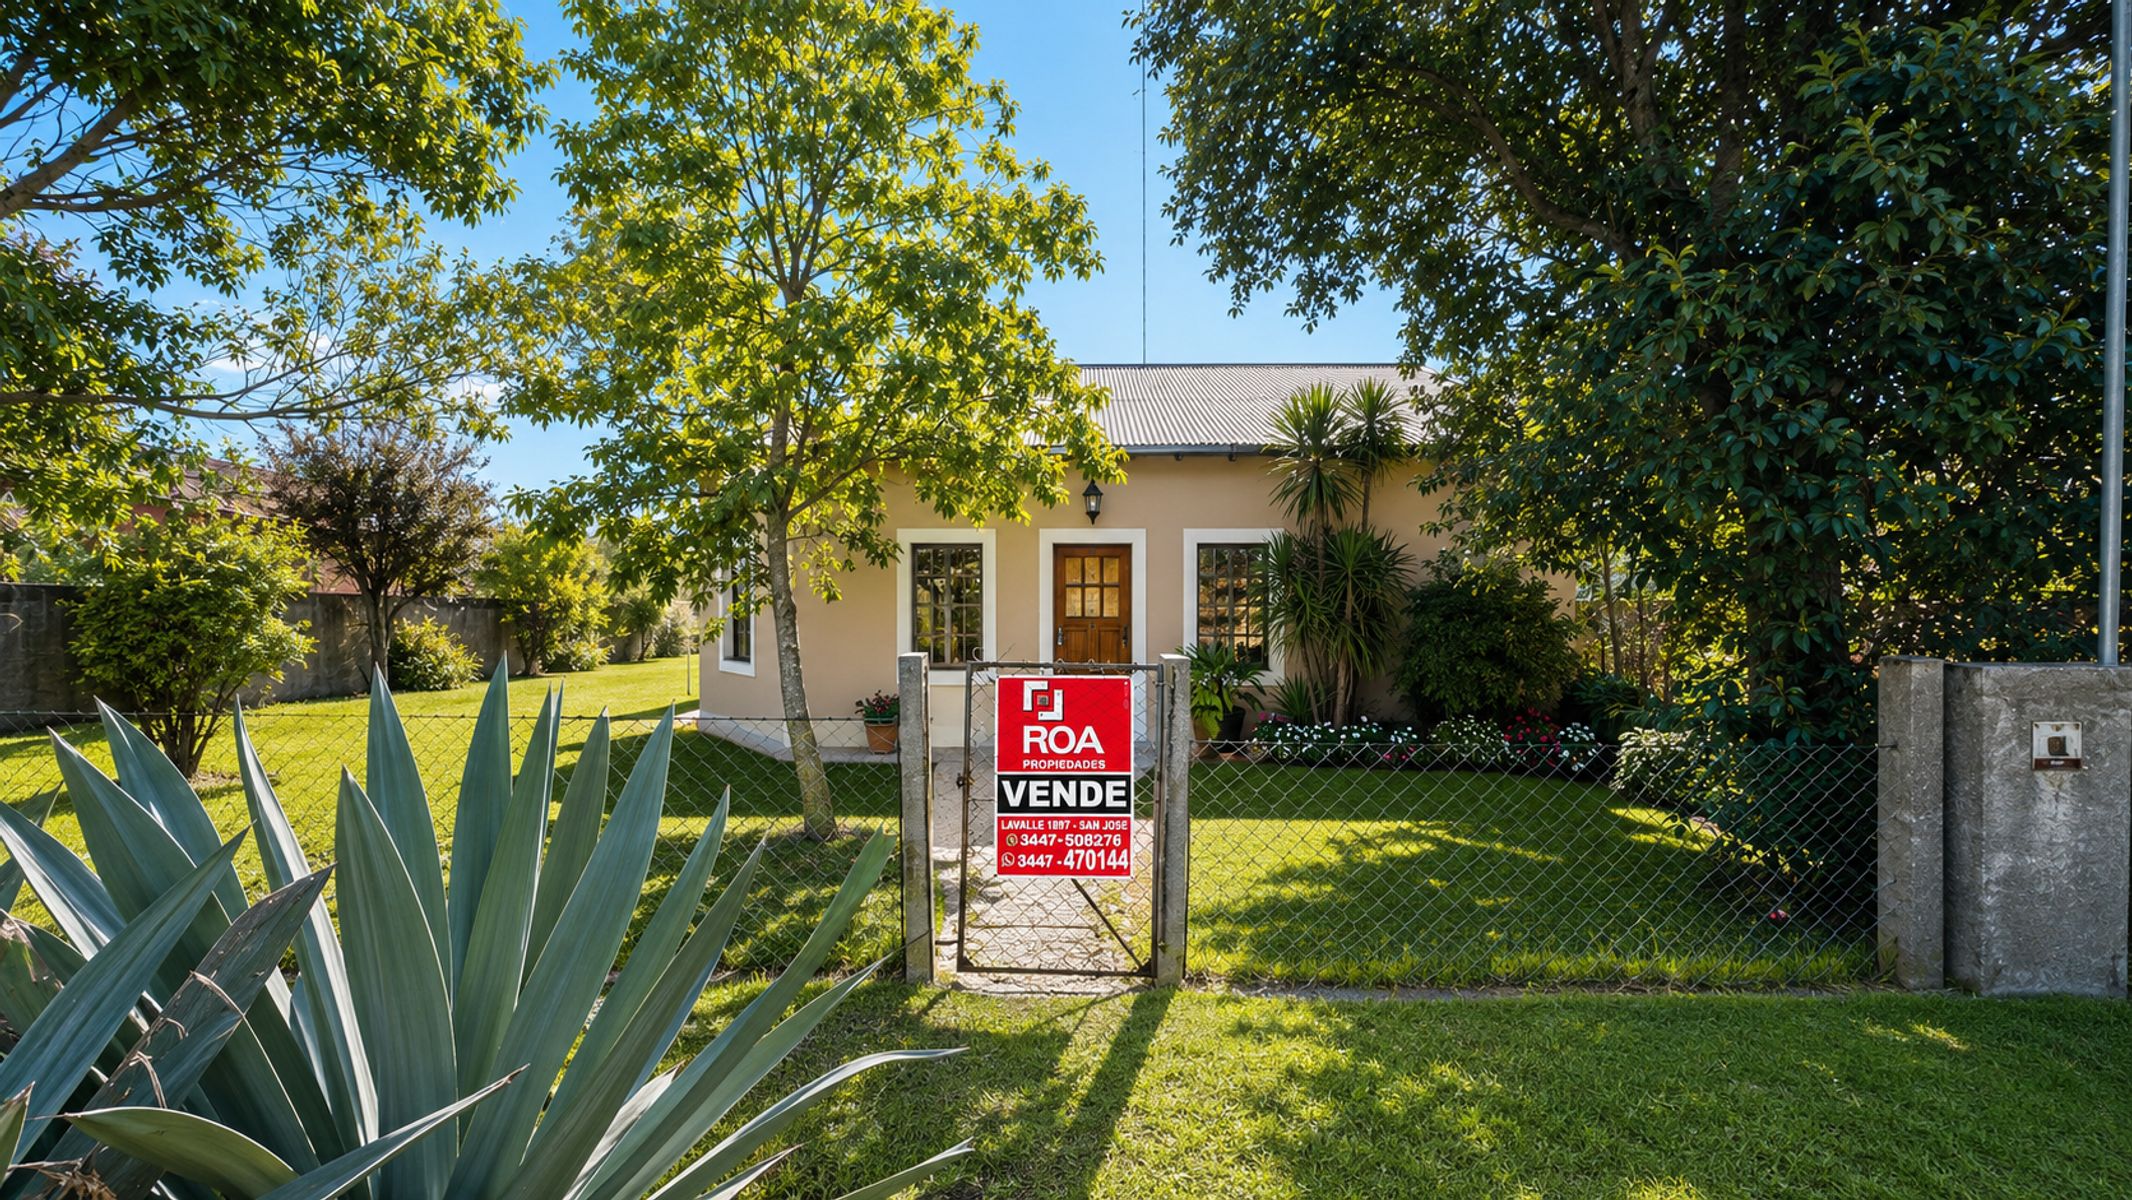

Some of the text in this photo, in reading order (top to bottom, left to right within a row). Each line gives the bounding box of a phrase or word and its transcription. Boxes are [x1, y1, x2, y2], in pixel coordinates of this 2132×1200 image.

[1023, 725, 1105, 754] ROA
[1023, 760, 1106, 769] PROPIEDADES
[1001, 780, 1127, 808] VENDE
[1001, 820, 1044, 830] LAVALLE
[1079, 820, 1100, 830] SAN
[1102, 820, 1128, 830] JOSE
